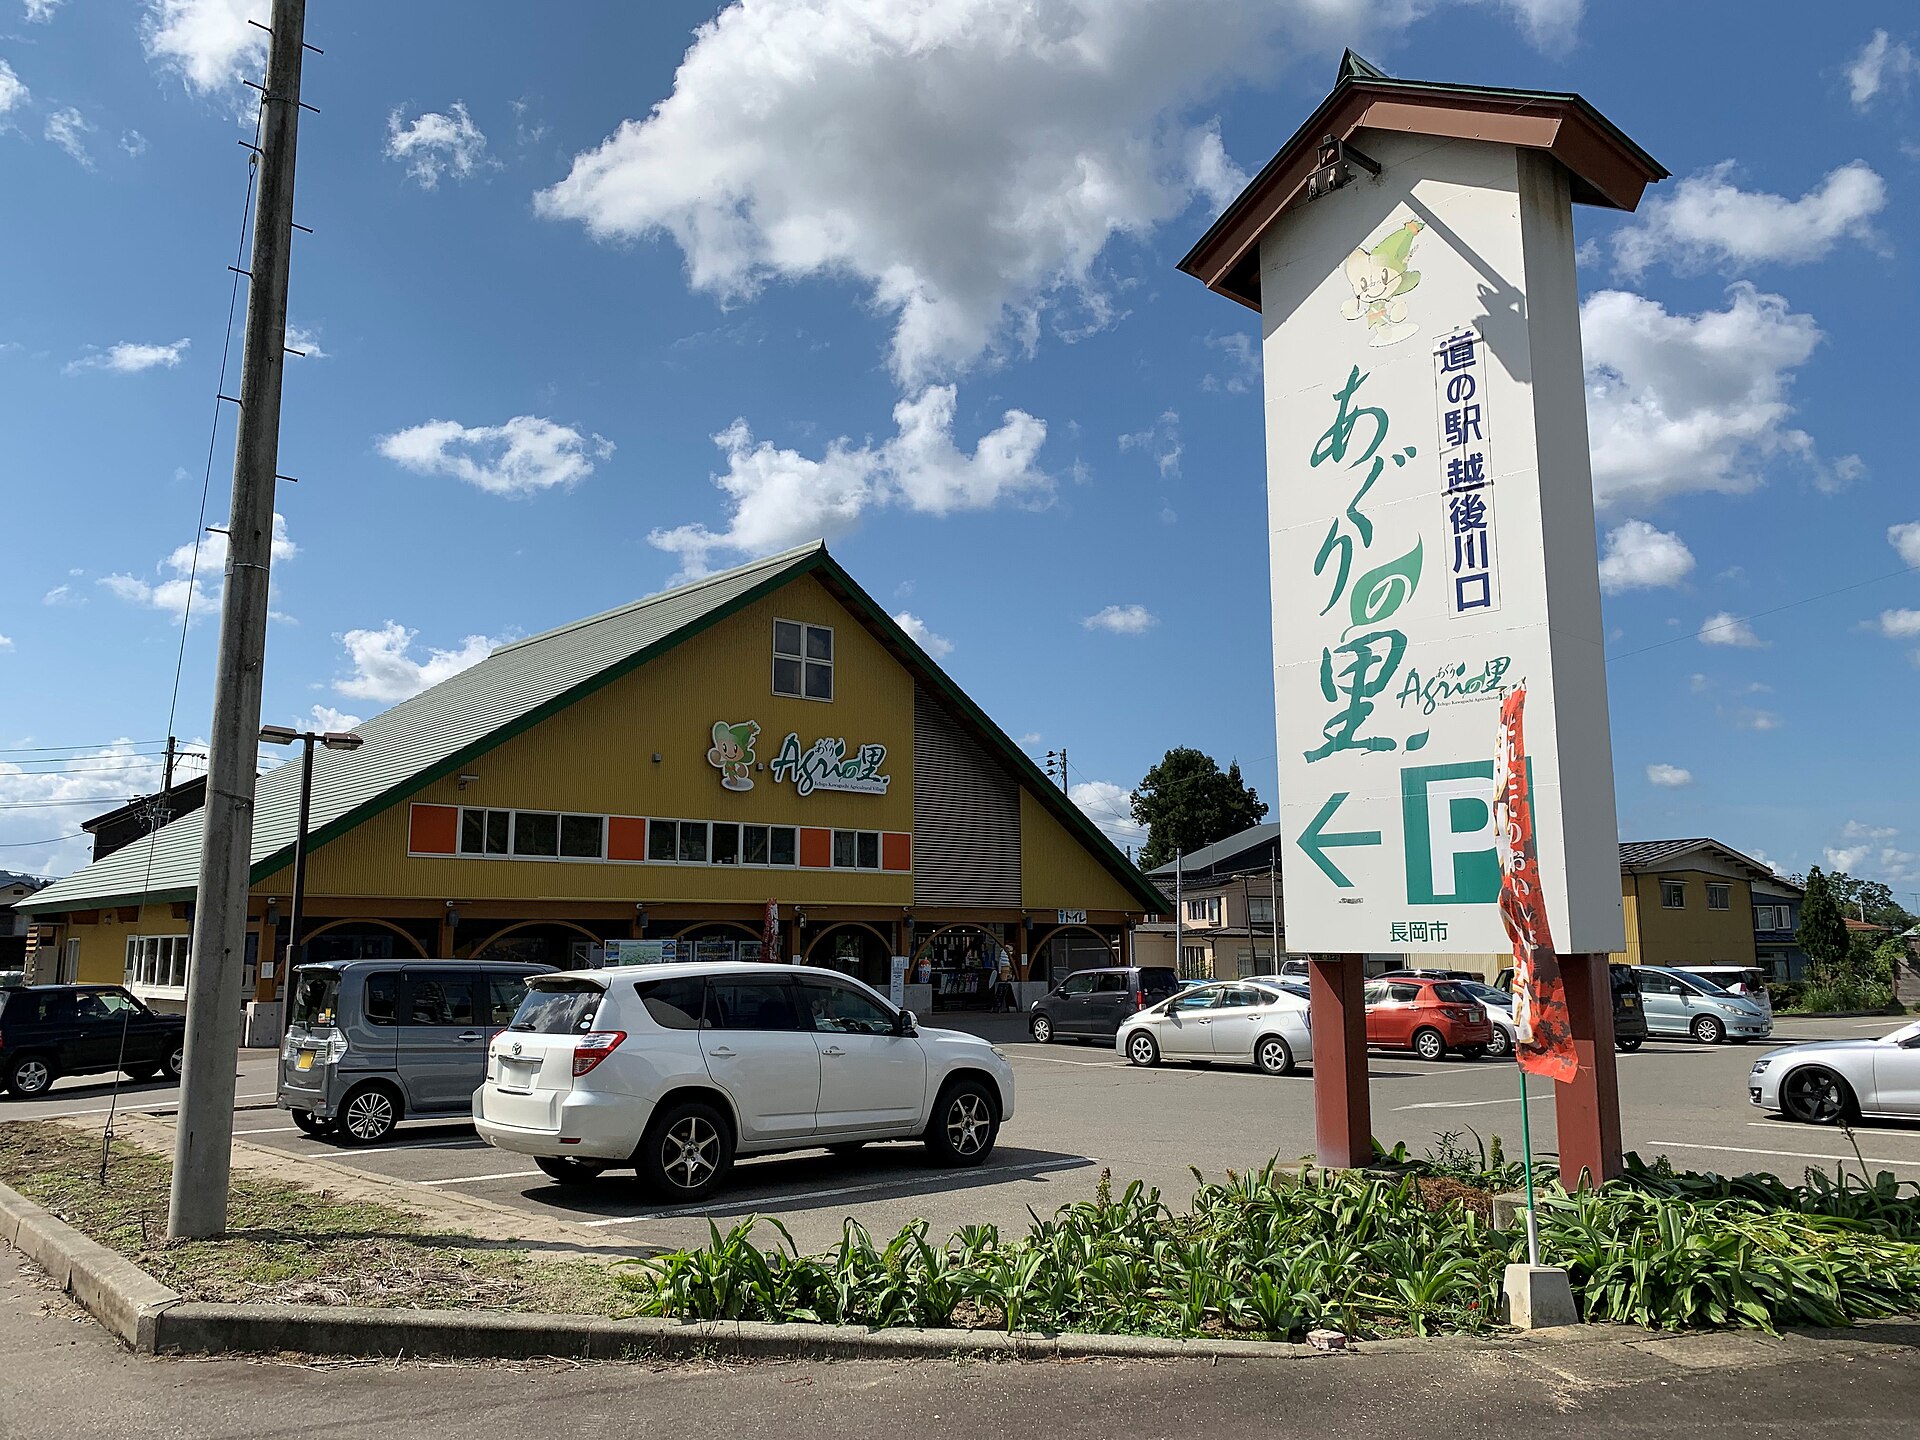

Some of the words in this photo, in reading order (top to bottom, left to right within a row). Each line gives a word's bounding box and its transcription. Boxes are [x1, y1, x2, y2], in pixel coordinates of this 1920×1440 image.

[1427, 777, 1499, 896] P
[1066, 911, 1087, 922] トイレ
[1390, 920, 1449, 942] 長岡市
